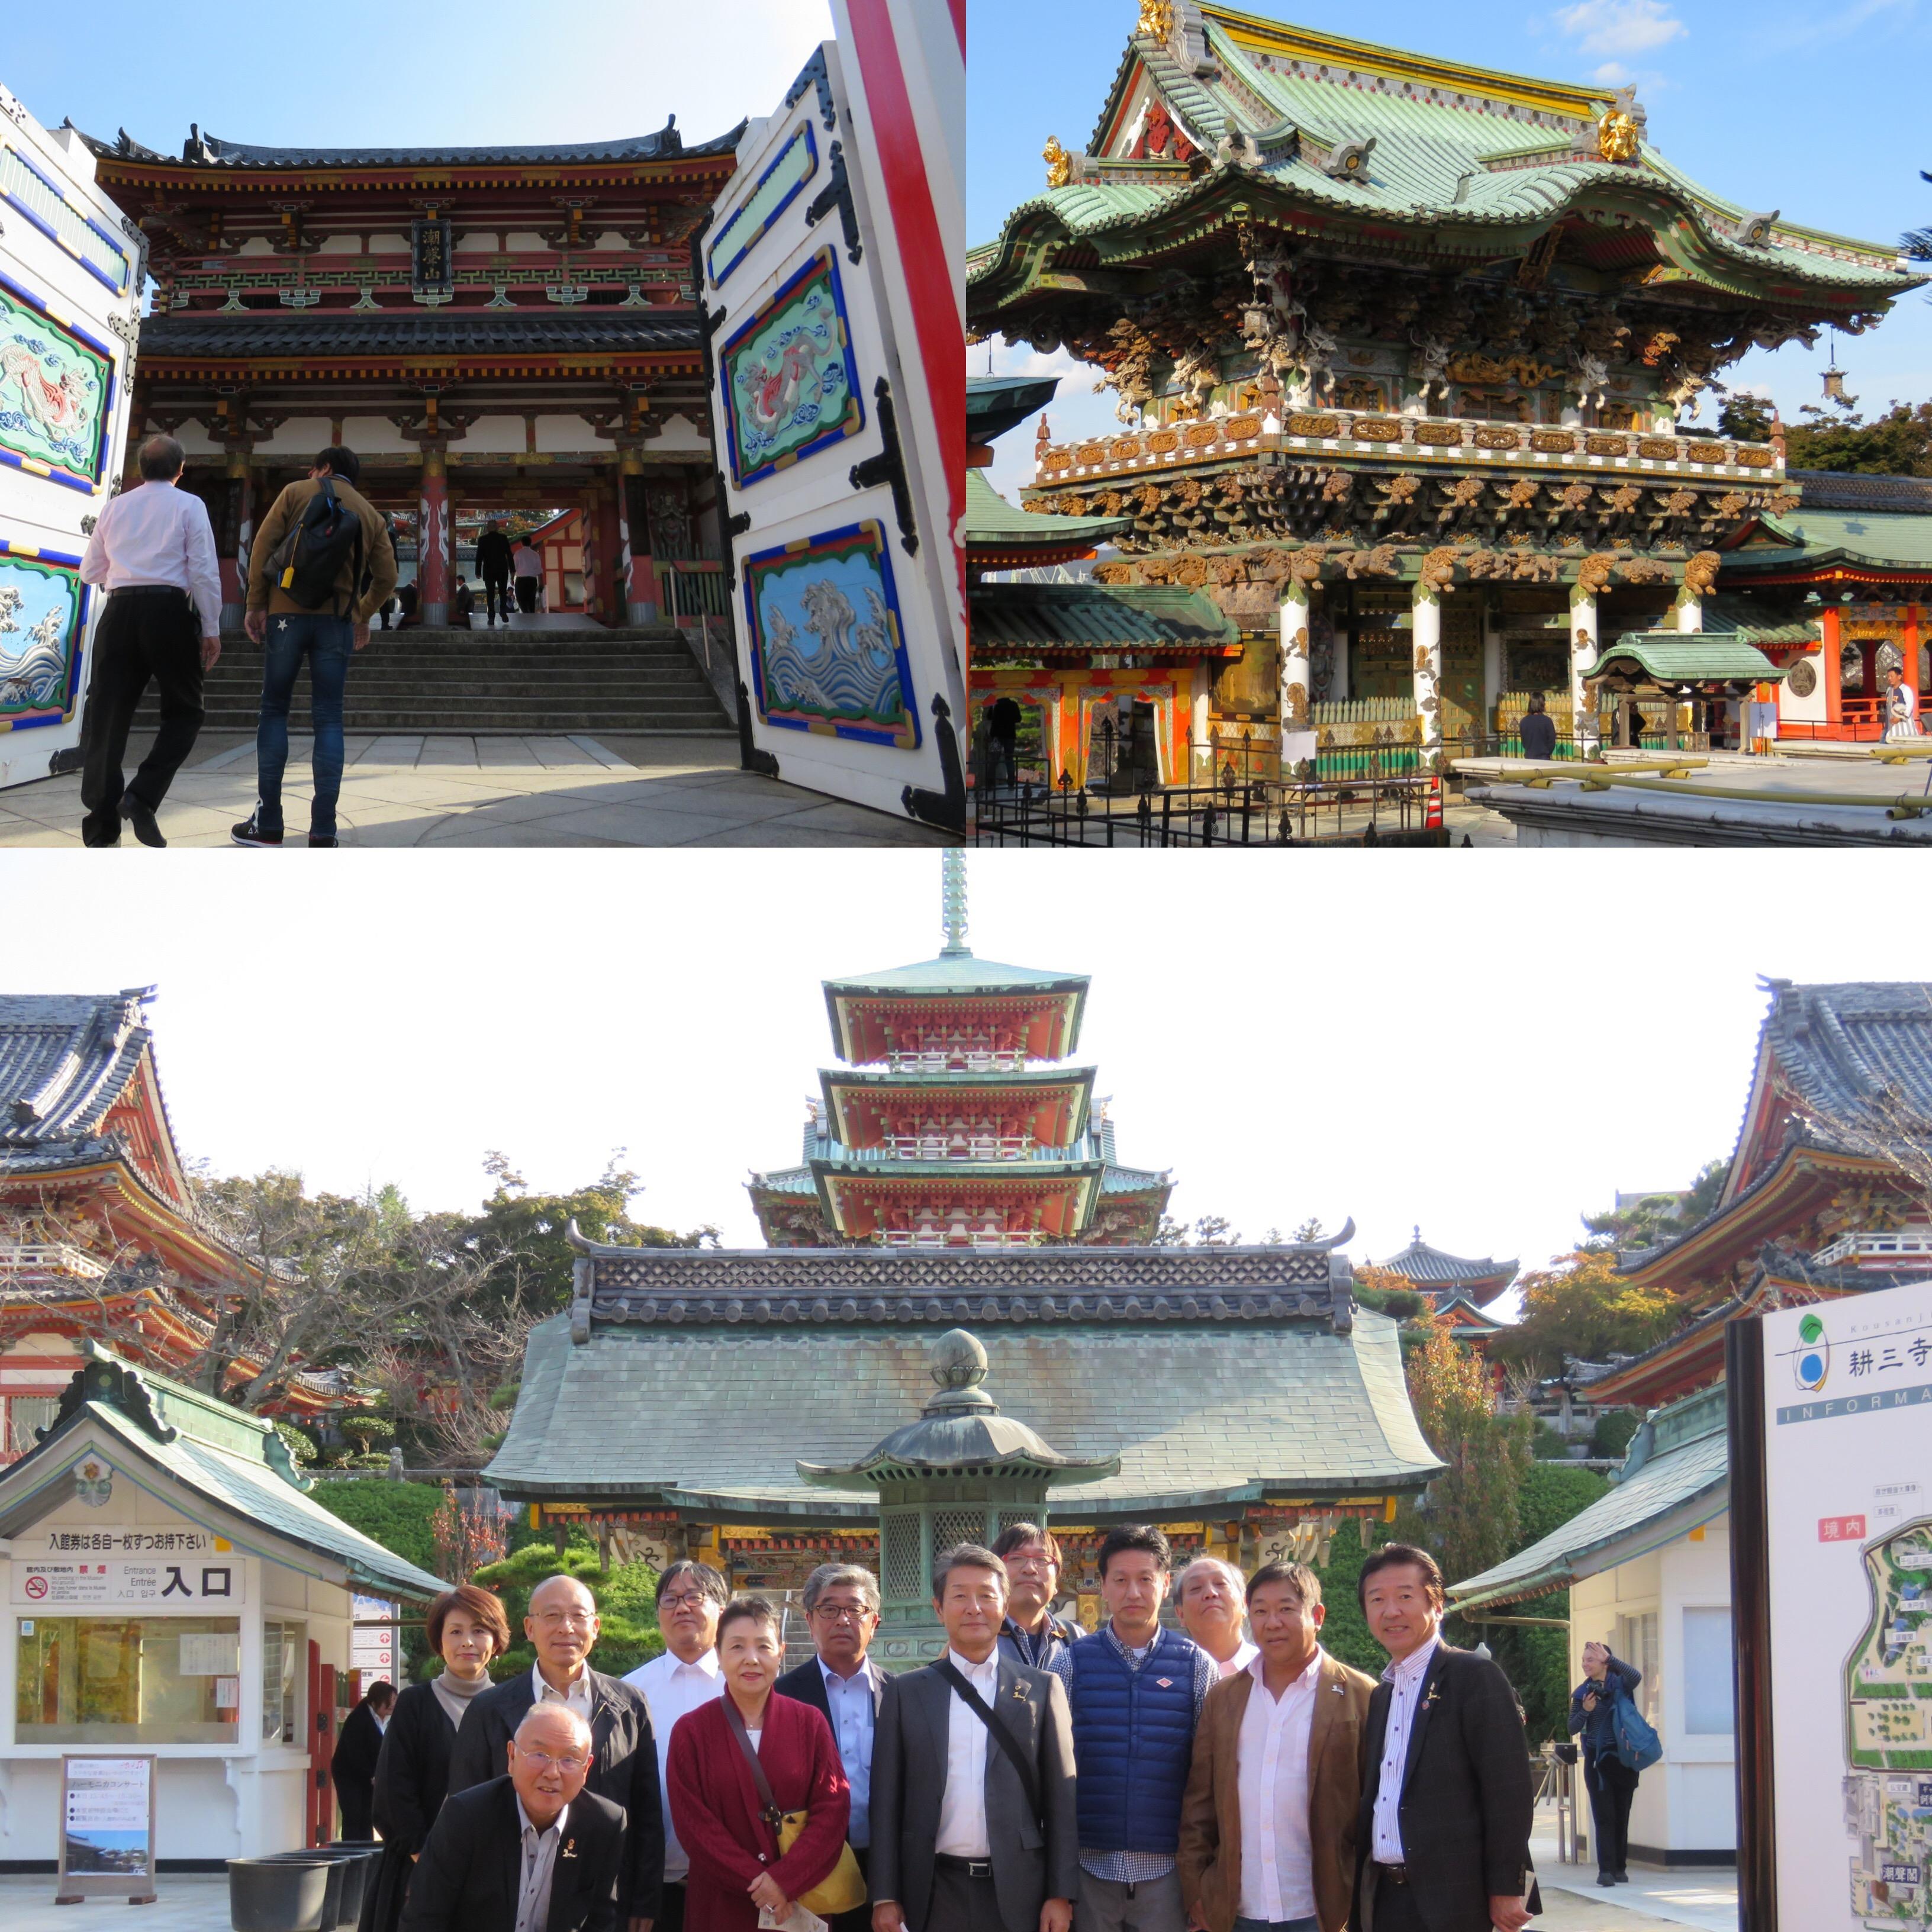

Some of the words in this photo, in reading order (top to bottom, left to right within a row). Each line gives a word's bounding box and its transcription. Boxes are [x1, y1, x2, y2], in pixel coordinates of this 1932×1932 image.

[1849, 1337, 1932, 1377] 耕三寺
[1786, 1388, 1931, 1421] INFORMA
[1823, 1518, 1860, 1539] 境内
[49, 1533, 207, 1550] 入館券は各自一枚ずつお持下さい
[124, 1566, 157, 1574] Entrance
[131, 1577, 157, 1586] Entrée
[161, 1566, 231, 1597] 入口
[141, 1590, 156, 1598] 입구
